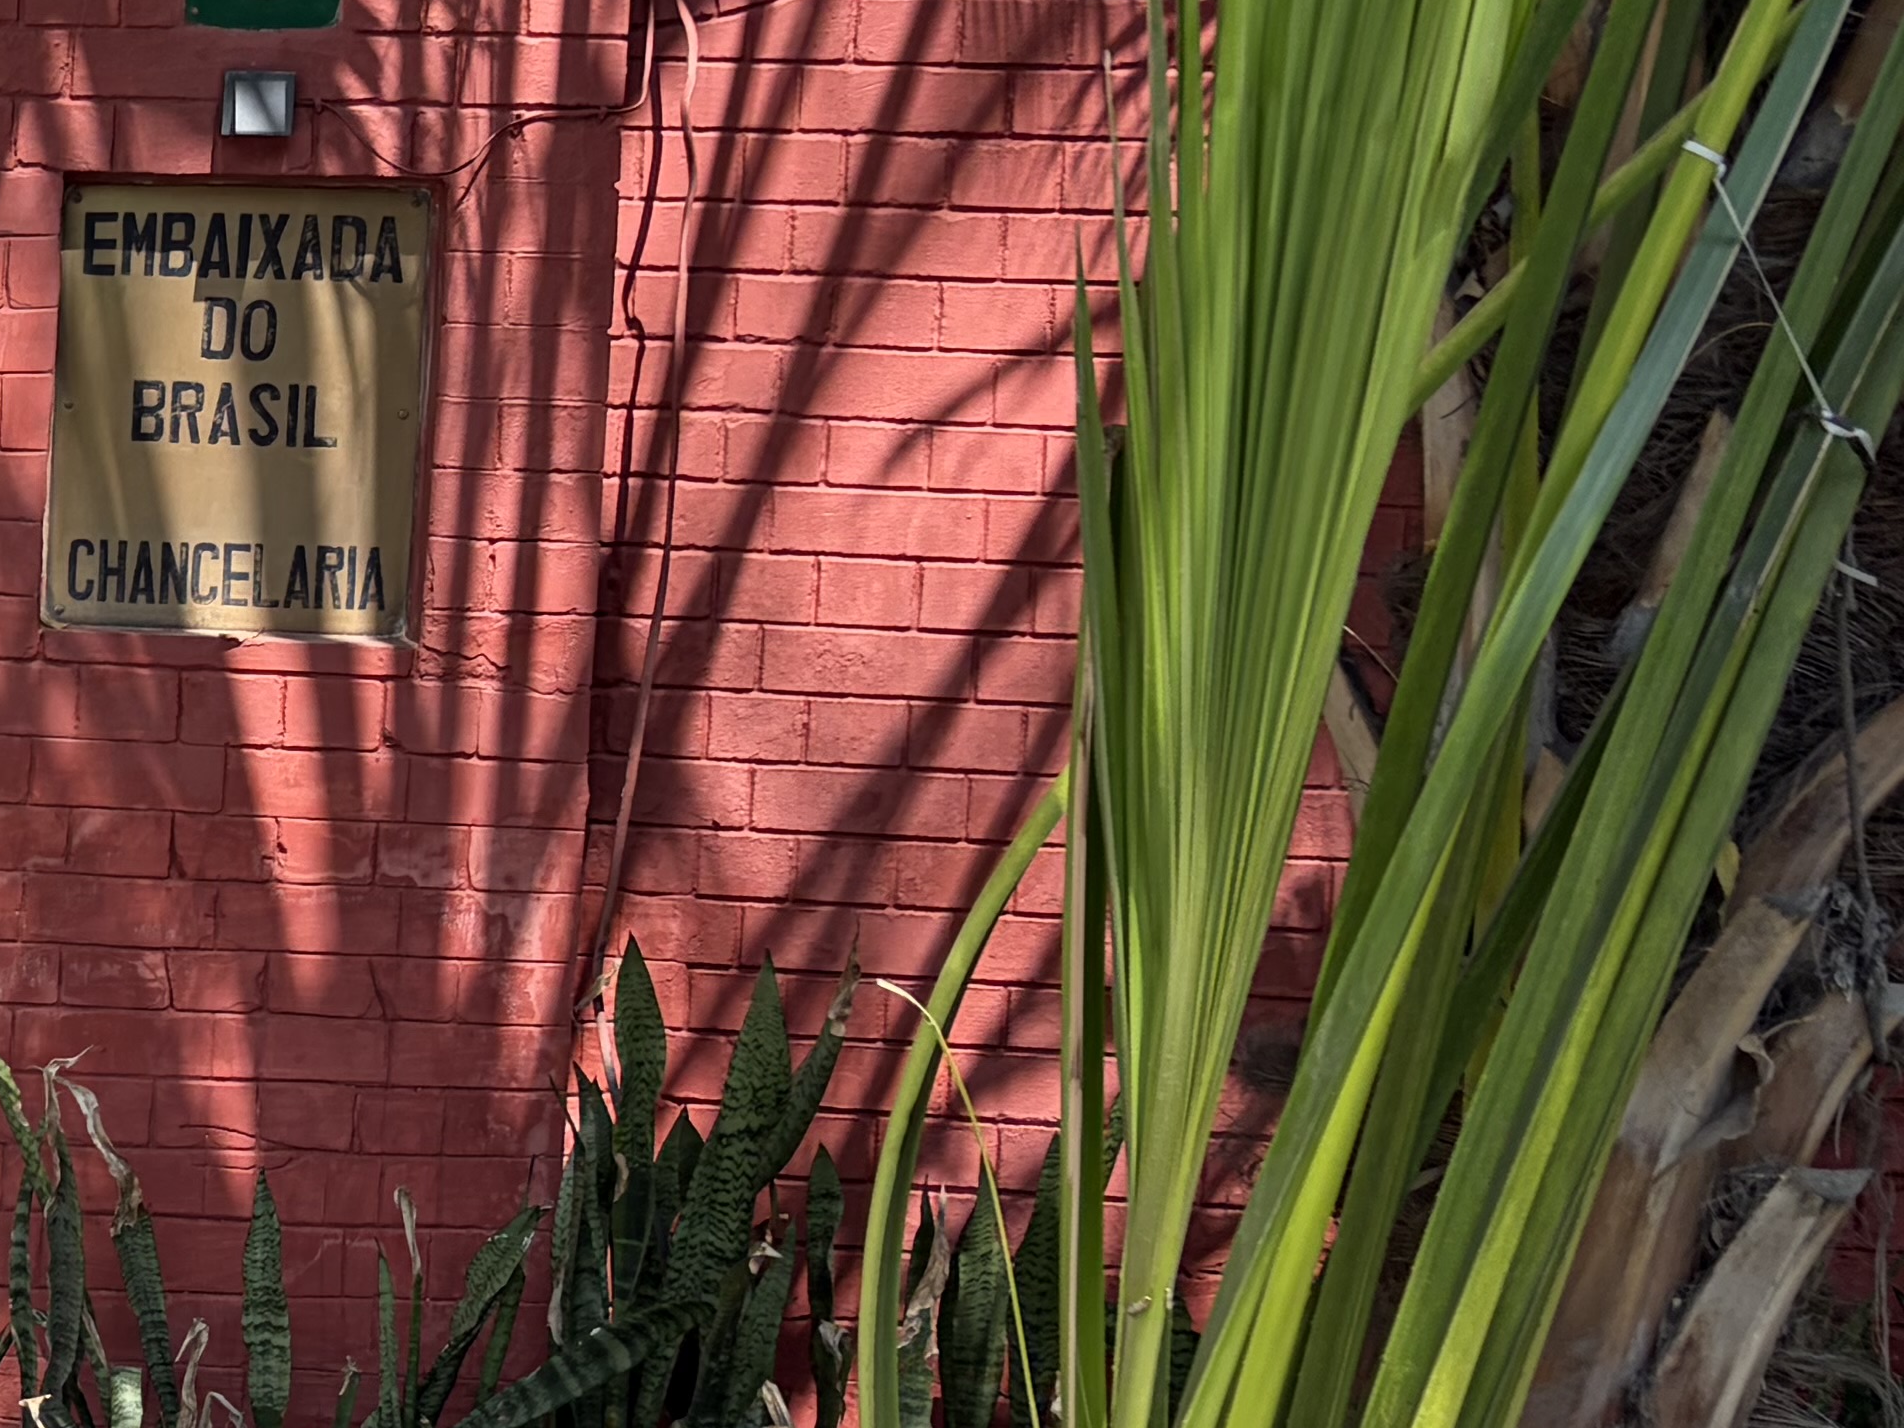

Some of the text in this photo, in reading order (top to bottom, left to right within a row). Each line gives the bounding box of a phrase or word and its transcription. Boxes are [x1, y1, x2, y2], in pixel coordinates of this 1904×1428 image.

[83, 212, 403, 283] EMBAIXADA
[200, 296, 278, 361] DO
[131, 379, 337, 448] BRASIL
[67, 538, 385, 612] CHANCELARIA
